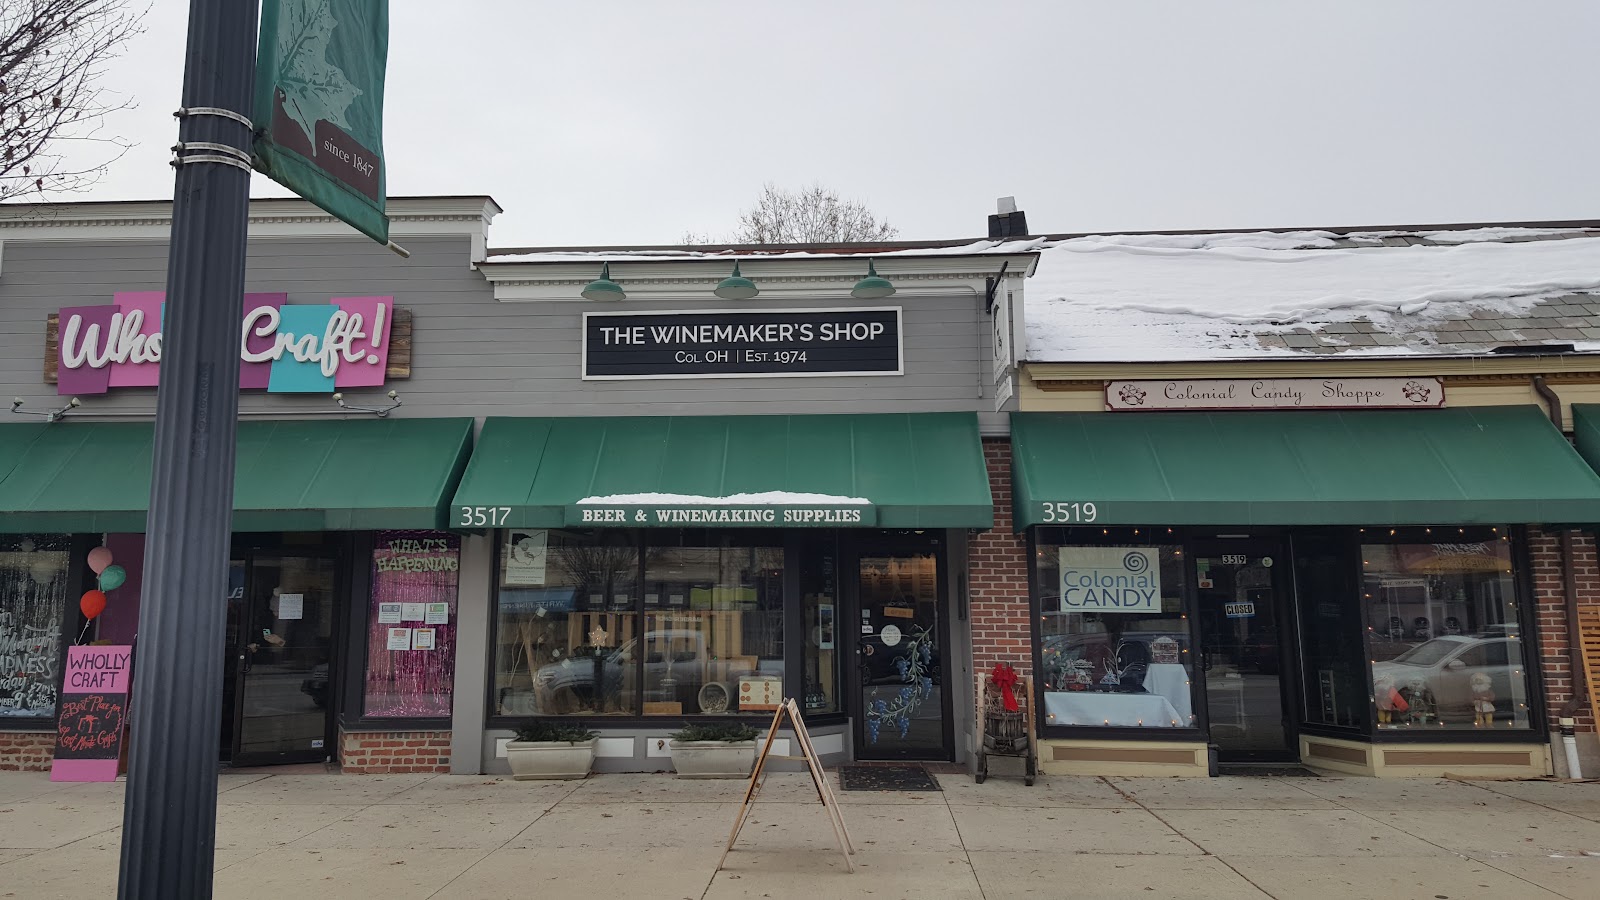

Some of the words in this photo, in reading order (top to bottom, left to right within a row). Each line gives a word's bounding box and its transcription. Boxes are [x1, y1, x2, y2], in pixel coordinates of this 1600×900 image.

[324, 137, 350, 163] since
[352, 153, 374, 178] 1847
[62, 309, 163, 369] Who
[241, 303, 386, 377] Craft!
[599, 326, 646, 345] THE
[650, 322, 814, 344] WINEMAKER'S
[819, 322, 884, 342] SHOP
[705, 350, 728, 363] OH
[773, 350, 807, 363] 1974
[1163, 382, 1237, 400] Colonial
[1250, 381, 1307, 405] Candy
[1321, 380, 1385, 403] Shoppe
[460, 506, 512, 526] 3517
[582, 509, 626, 523] BEER
[634, 509, 647, 523] &
[655, 508, 776, 523] WINEMAKING
[783, 508, 861, 523] SUPPLIES
[1042, 502, 1097, 522] 3519
[388, 539, 448, 554] WHAT'S
[375, 556, 459, 574] HAPPENING
[1223, 555, 1245, 564] 3519
[1063, 570, 1157, 589] Colonial
[1064, 588, 1156, 607] CANDY
[1226, 604, 1253, 615] CLOSED
[70, 653, 130, 670] WHOLLY
[71, 672, 119, 688] CRAFT
[63, 697, 89, 719] Best
[88, 695, 110, 712] Place
[58, 726, 78, 748] Last
[97, 730, 117, 748] Gifts
